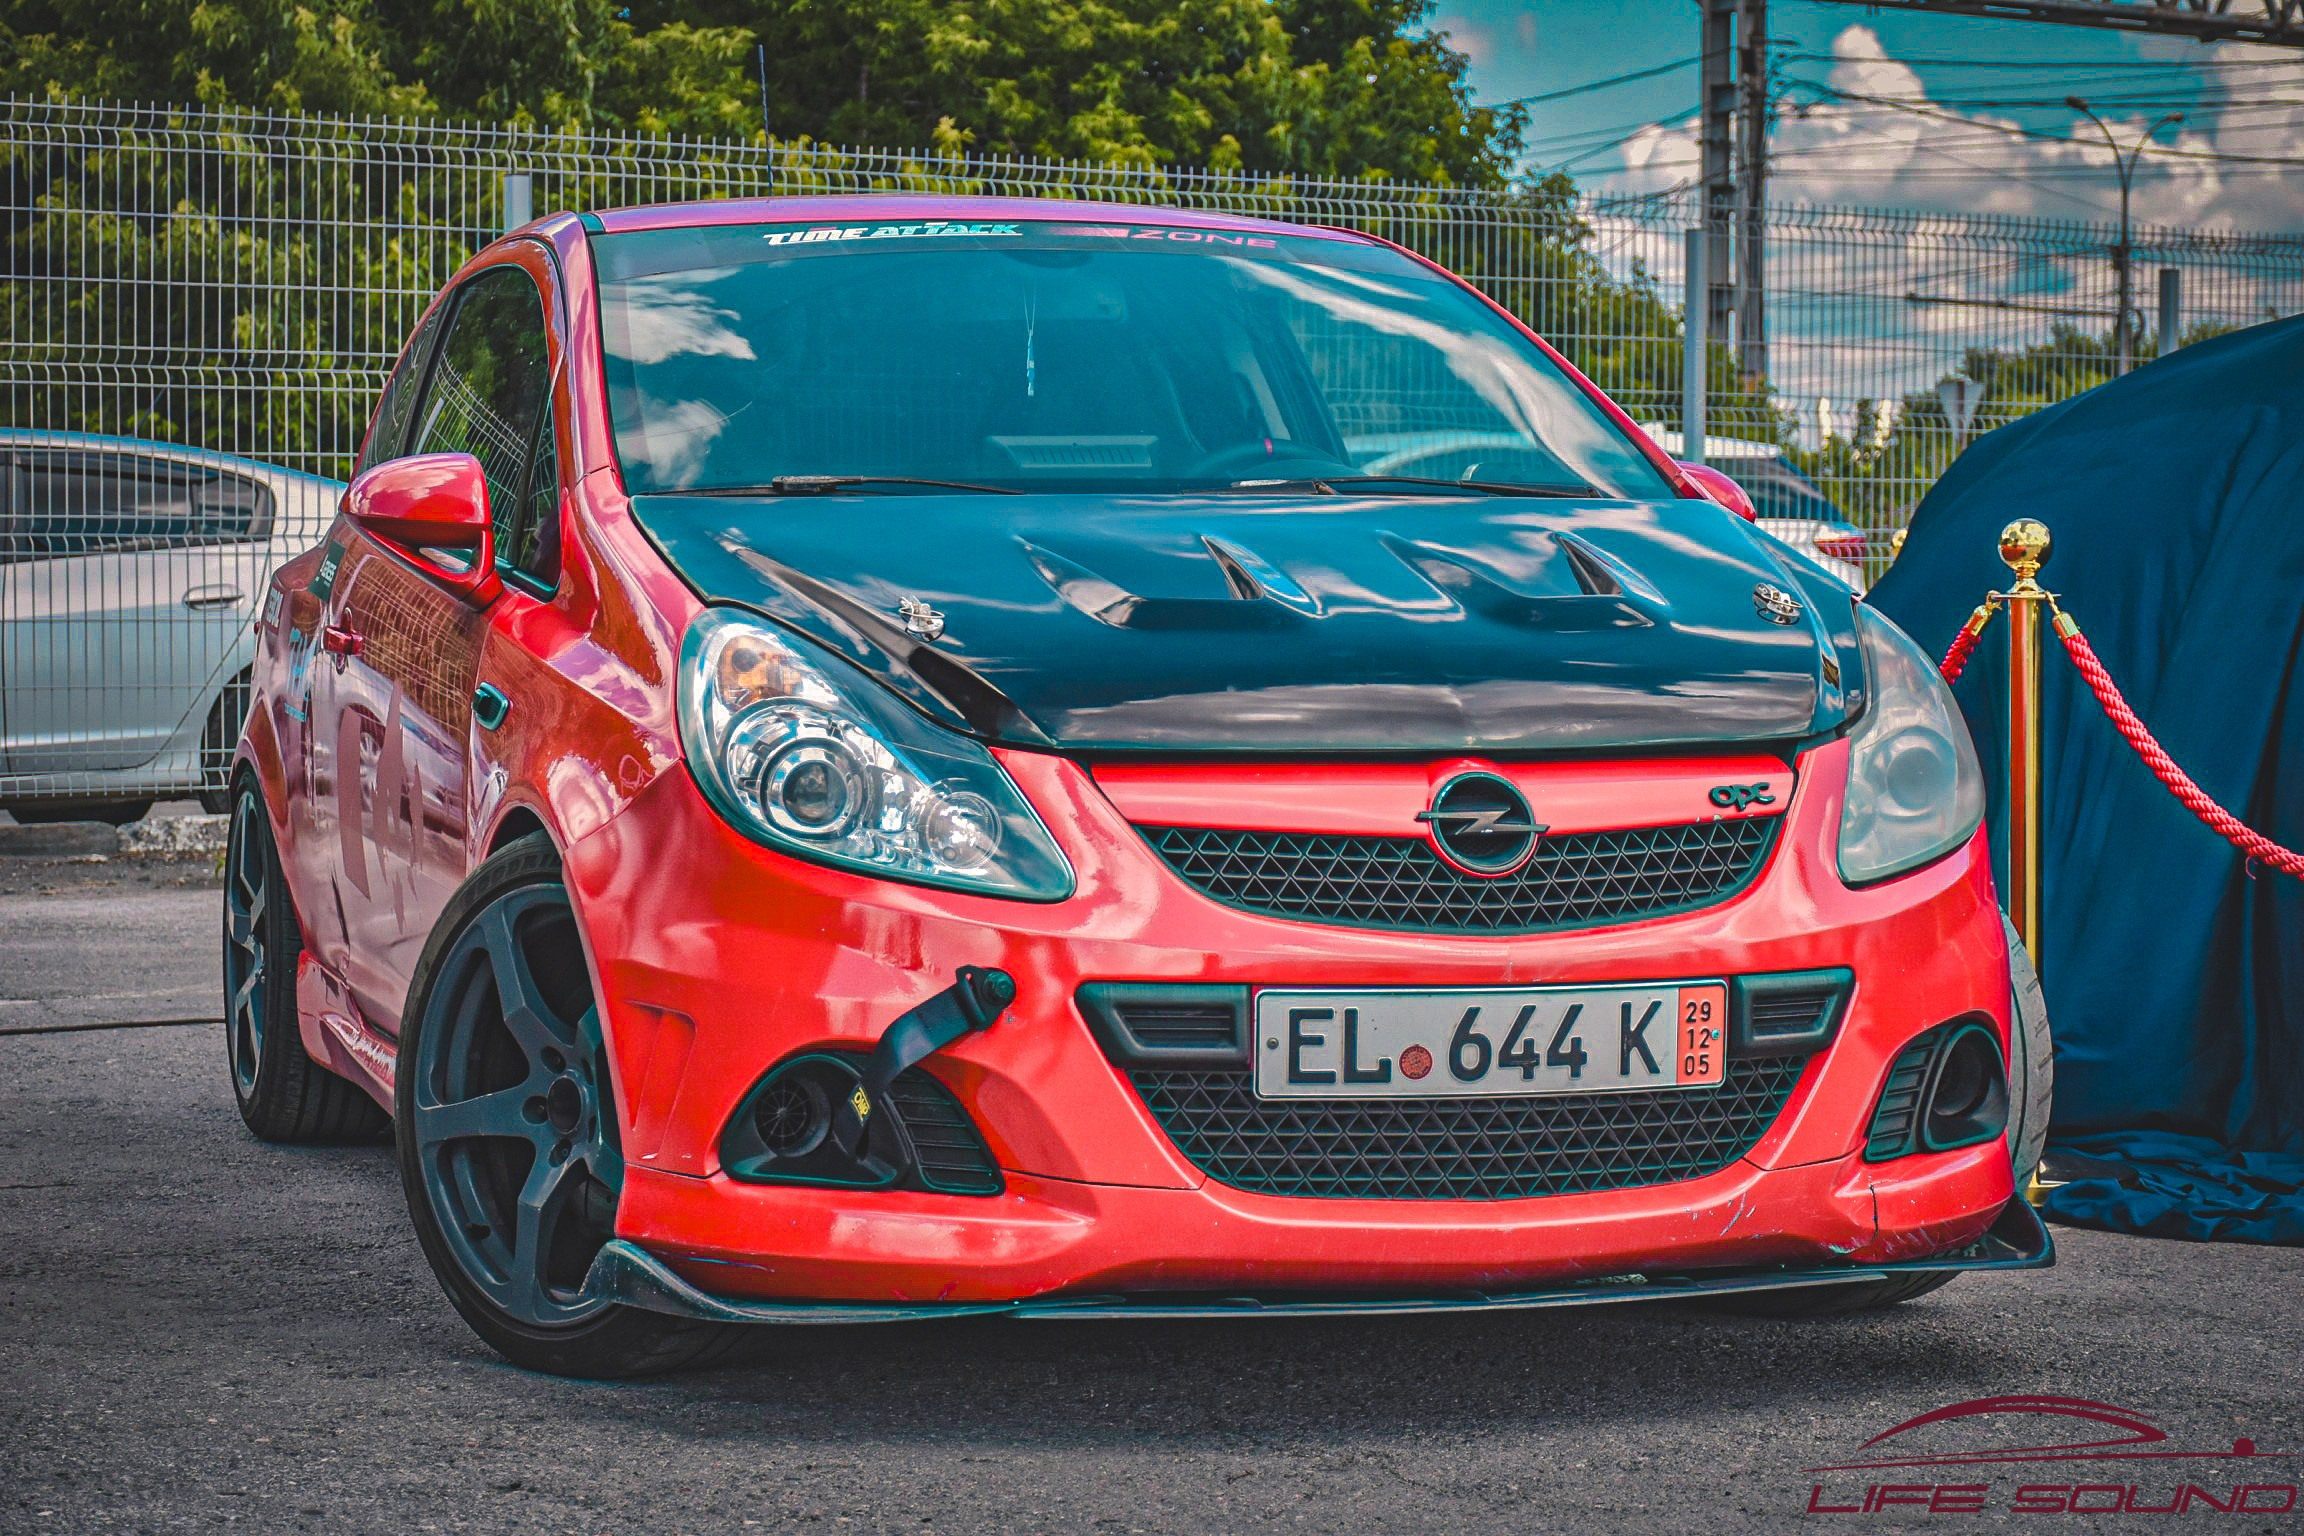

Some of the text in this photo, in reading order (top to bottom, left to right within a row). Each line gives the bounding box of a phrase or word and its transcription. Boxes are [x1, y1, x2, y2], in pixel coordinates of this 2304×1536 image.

[763, 222, 1020, 245] TIME ATTACK
[1131, 229, 1277, 248] ZONE
[1686, 1001, 1711, 1023] 29
[1288, 1007, 1392, 1084] EL
[1448, 1002, 1588, 1082] 644
[1619, 999, 1663, 1076] K
[1687, 1028, 1710, 1049] 12
[1685, 1054, 1709, 1075] 05
[854, 1091, 869, 1116] OMP
